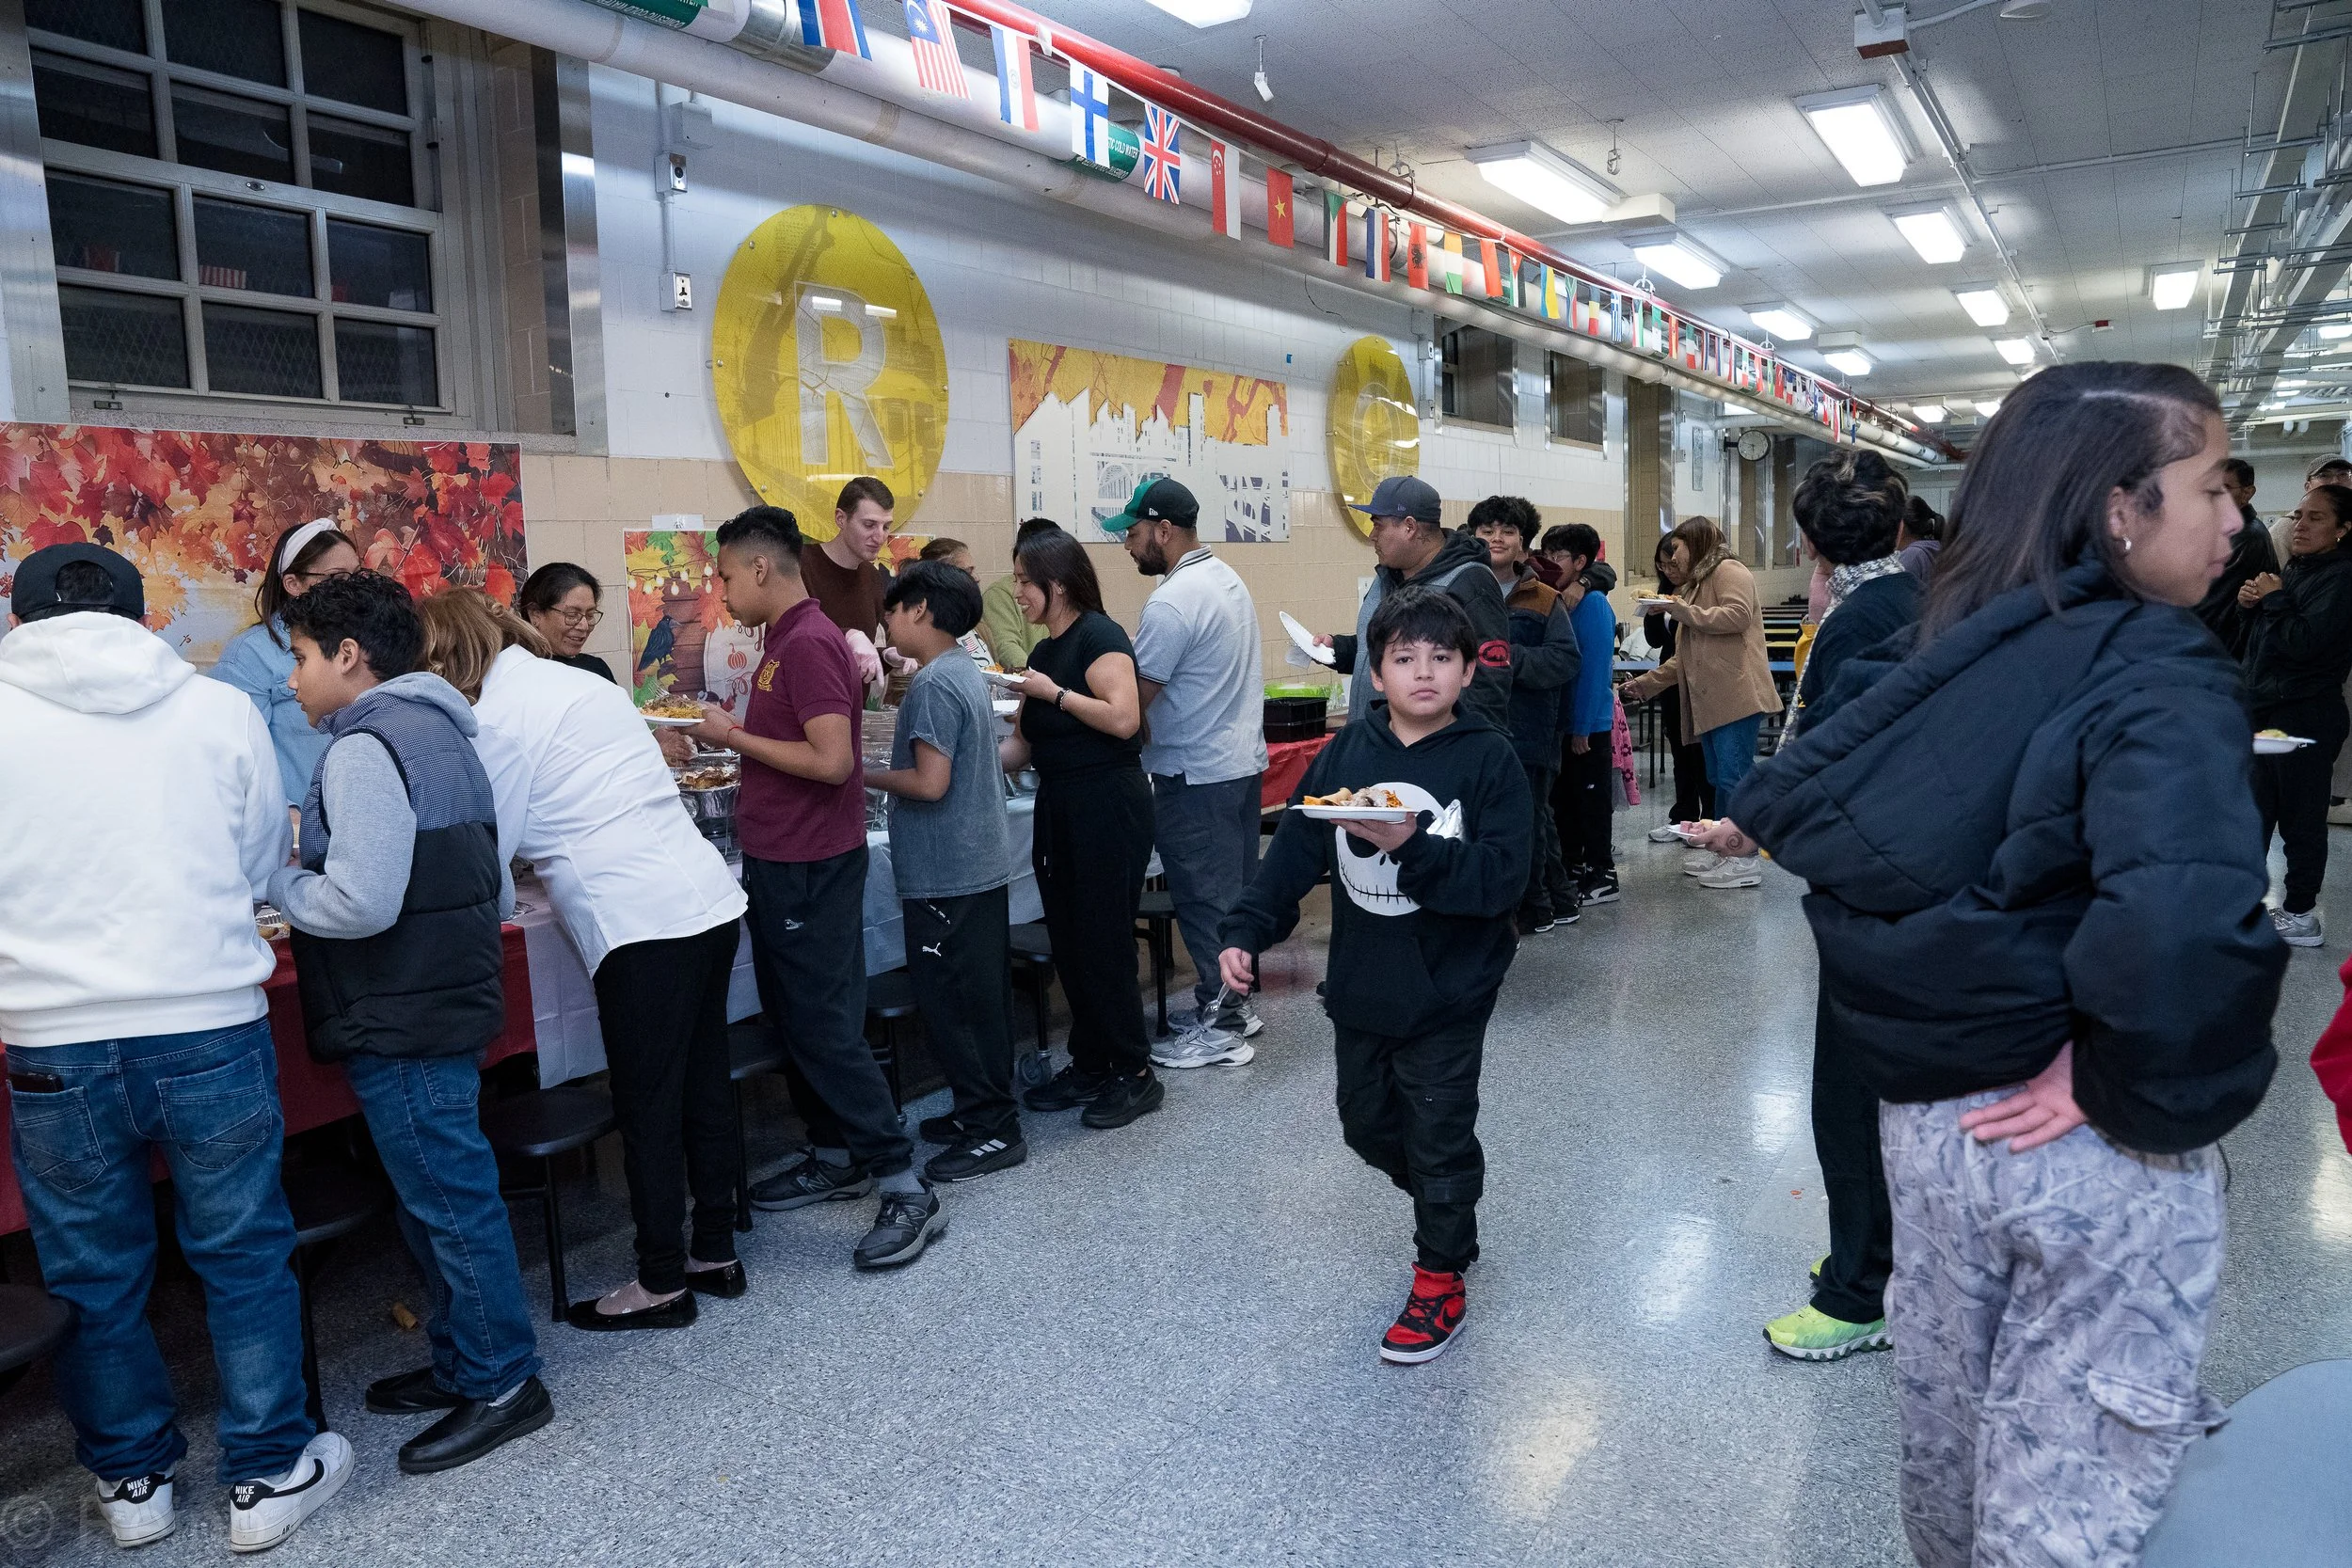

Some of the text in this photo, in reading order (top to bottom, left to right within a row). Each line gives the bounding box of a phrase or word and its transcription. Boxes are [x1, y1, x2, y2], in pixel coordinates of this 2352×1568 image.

[624, 5, 649, 17] COLD
[644, 11, 685, 28] DOMESTIC
[1115, 140, 1126, 154] COLD
[1125, 144, 1139, 159] WATER
[793, 280, 896, 468] R
[126, 1475, 151, 1492] NIKE
[234, 1485, 255, 1496] NIKE
[131, 1485, 148, 1498] AIR
[235, 1494, 250, 1503] AIR
